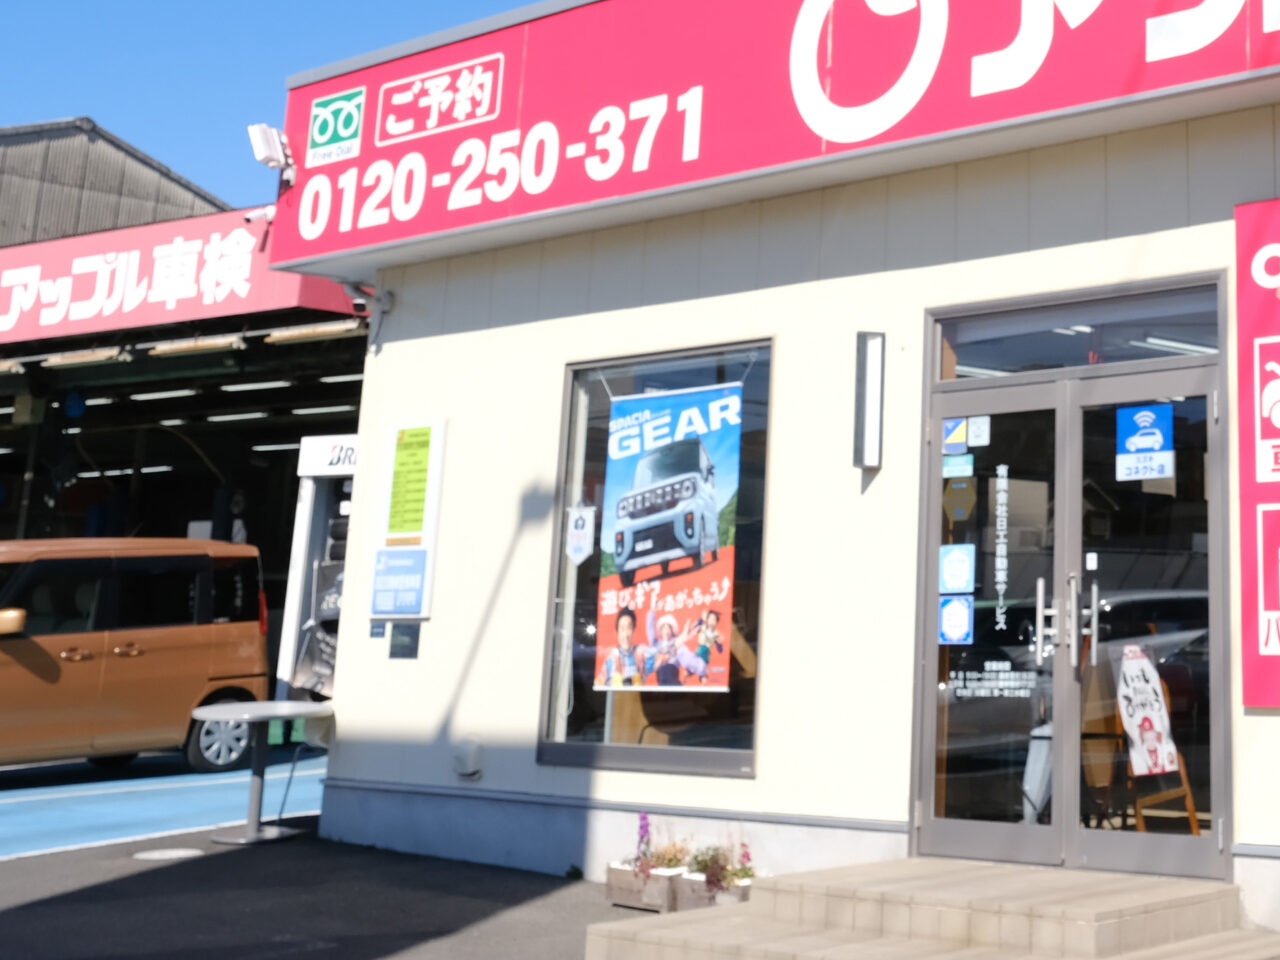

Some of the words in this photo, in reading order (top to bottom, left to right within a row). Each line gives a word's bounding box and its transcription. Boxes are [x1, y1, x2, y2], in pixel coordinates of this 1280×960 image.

[385, 65, 494, 135] ご予約
[299, 85, 703, 240] 0120-250-371
[608, 394, 742, 460] GEAR
